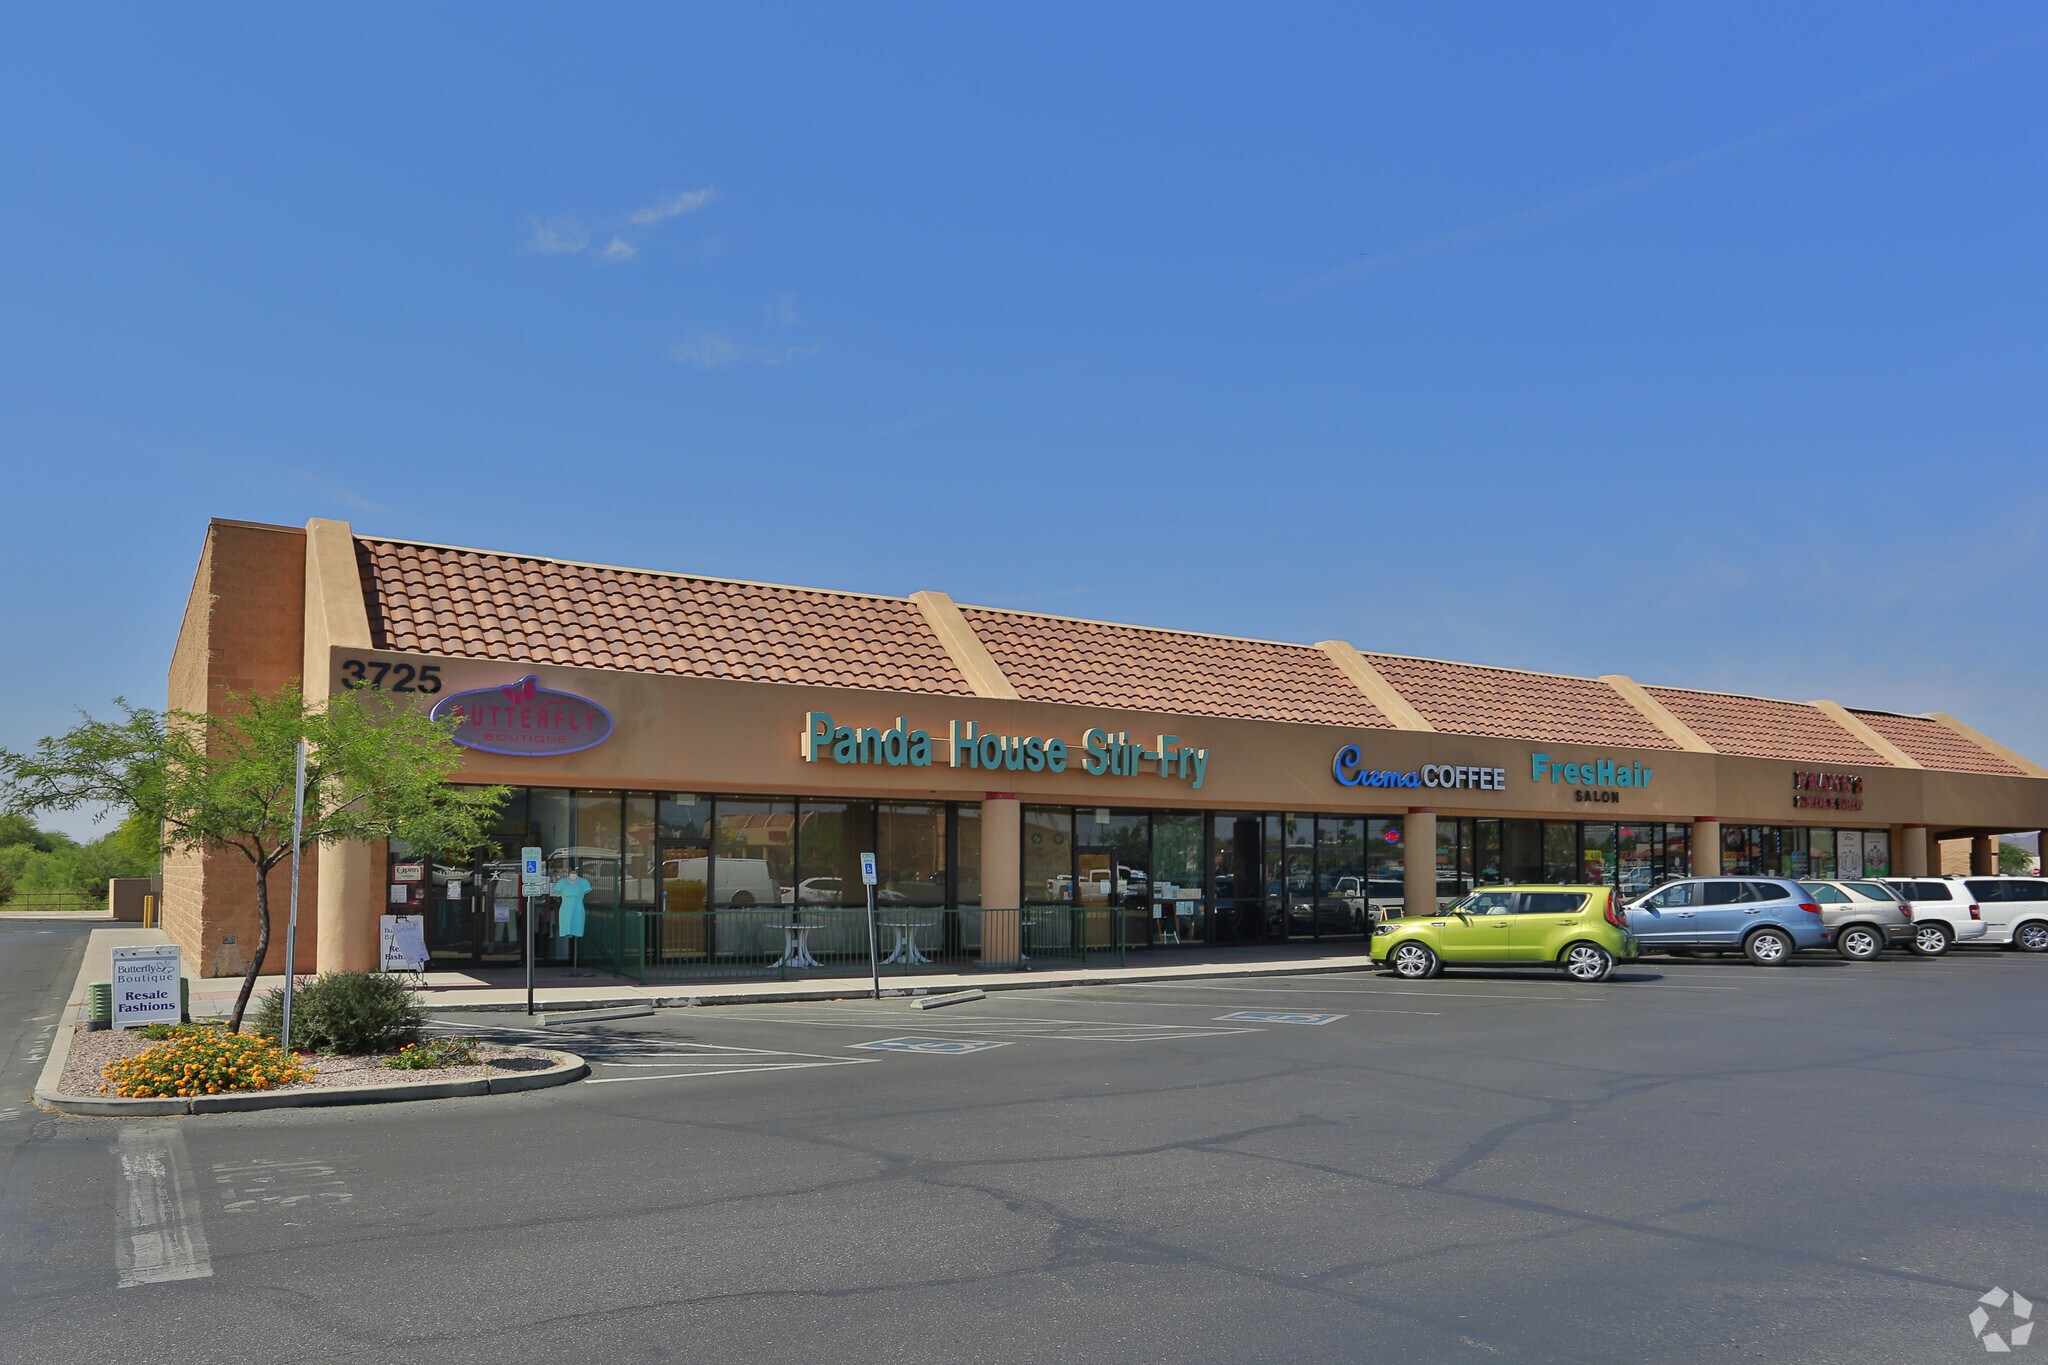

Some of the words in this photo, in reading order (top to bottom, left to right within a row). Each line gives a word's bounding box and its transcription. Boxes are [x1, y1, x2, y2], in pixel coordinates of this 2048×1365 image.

[341, 659, 442, 694] 3725
[483, 732, 567, 744] BOUTIQUE
[802, 711, 931, 766] Panda
[949, 719, 1067, 772] House
[1082, 727, 1209, 788] Stir-Fry
[1332, 744, 1422, 789] Crema
[1421, 764, 1506, 790] COFFEE
[1531, 752, 1654, 789] FresHair
[1575, 789, 1620, 803] SALON
[396, 866, 419, 875] Open
[117, 964, 156, 974] Butterfly
[117, 973, 173, 984] Boutique
[125, 990, 168, 1001] Resale
[118, 1001, 176, 1013] Fashions
